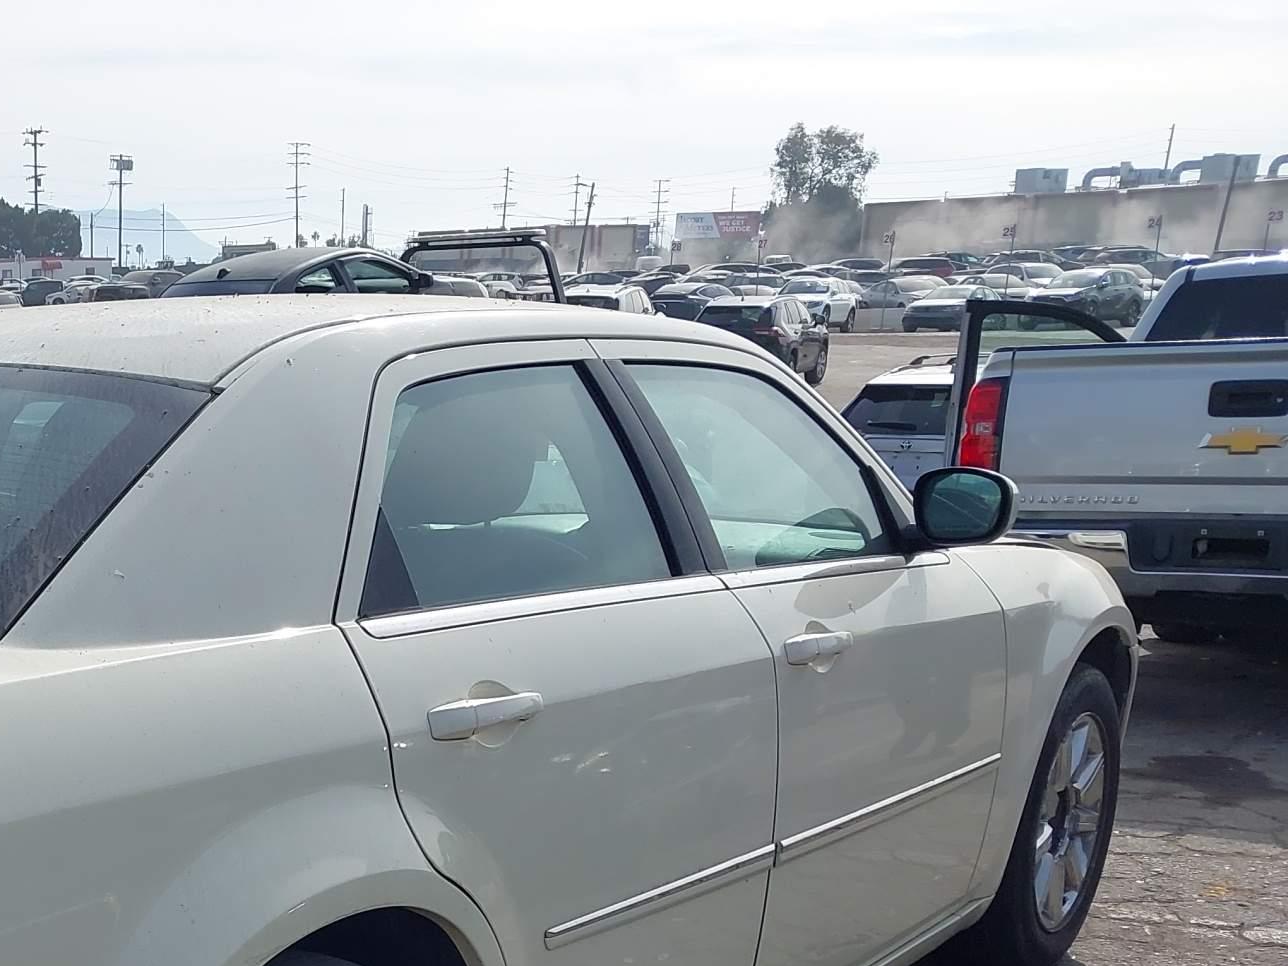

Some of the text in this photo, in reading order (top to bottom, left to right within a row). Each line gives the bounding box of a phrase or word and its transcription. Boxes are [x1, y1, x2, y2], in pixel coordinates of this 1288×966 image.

[1268, 211, 1284, 222] 23
[1148, 217, 1162, 228] 24
[1003, 226, 1016, 237] 25
[672, 242, 682, 252] 28
[758, 239, 768, 249] 27
